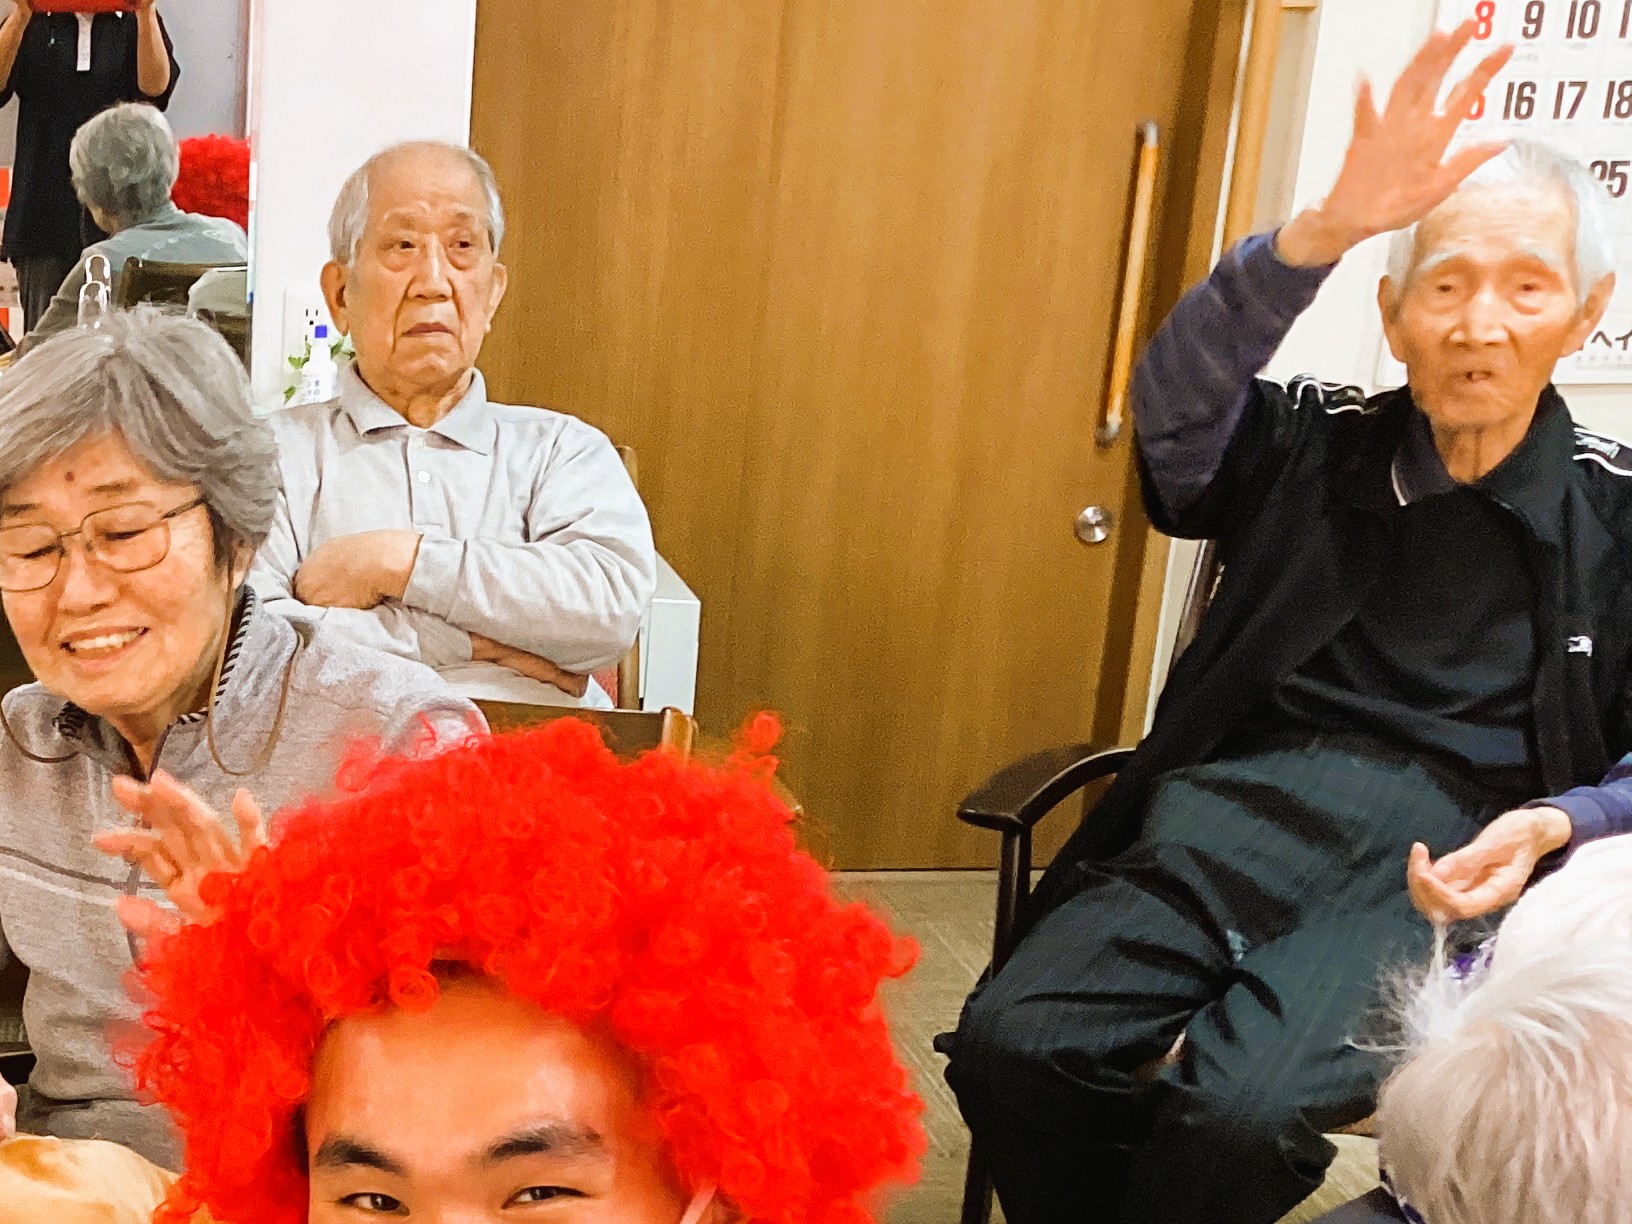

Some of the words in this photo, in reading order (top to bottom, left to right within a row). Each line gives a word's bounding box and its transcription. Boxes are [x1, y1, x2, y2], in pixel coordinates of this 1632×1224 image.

[1473, 0, 1495, 40] 8
[1522, 0, 1545, 39] 9
[1566, 0, 1601, 39] 10
[1503, 81, 1537, 120] 16
[1552, 81, 1588, 120] 17
[1602, 80, 1632, 119] 18
